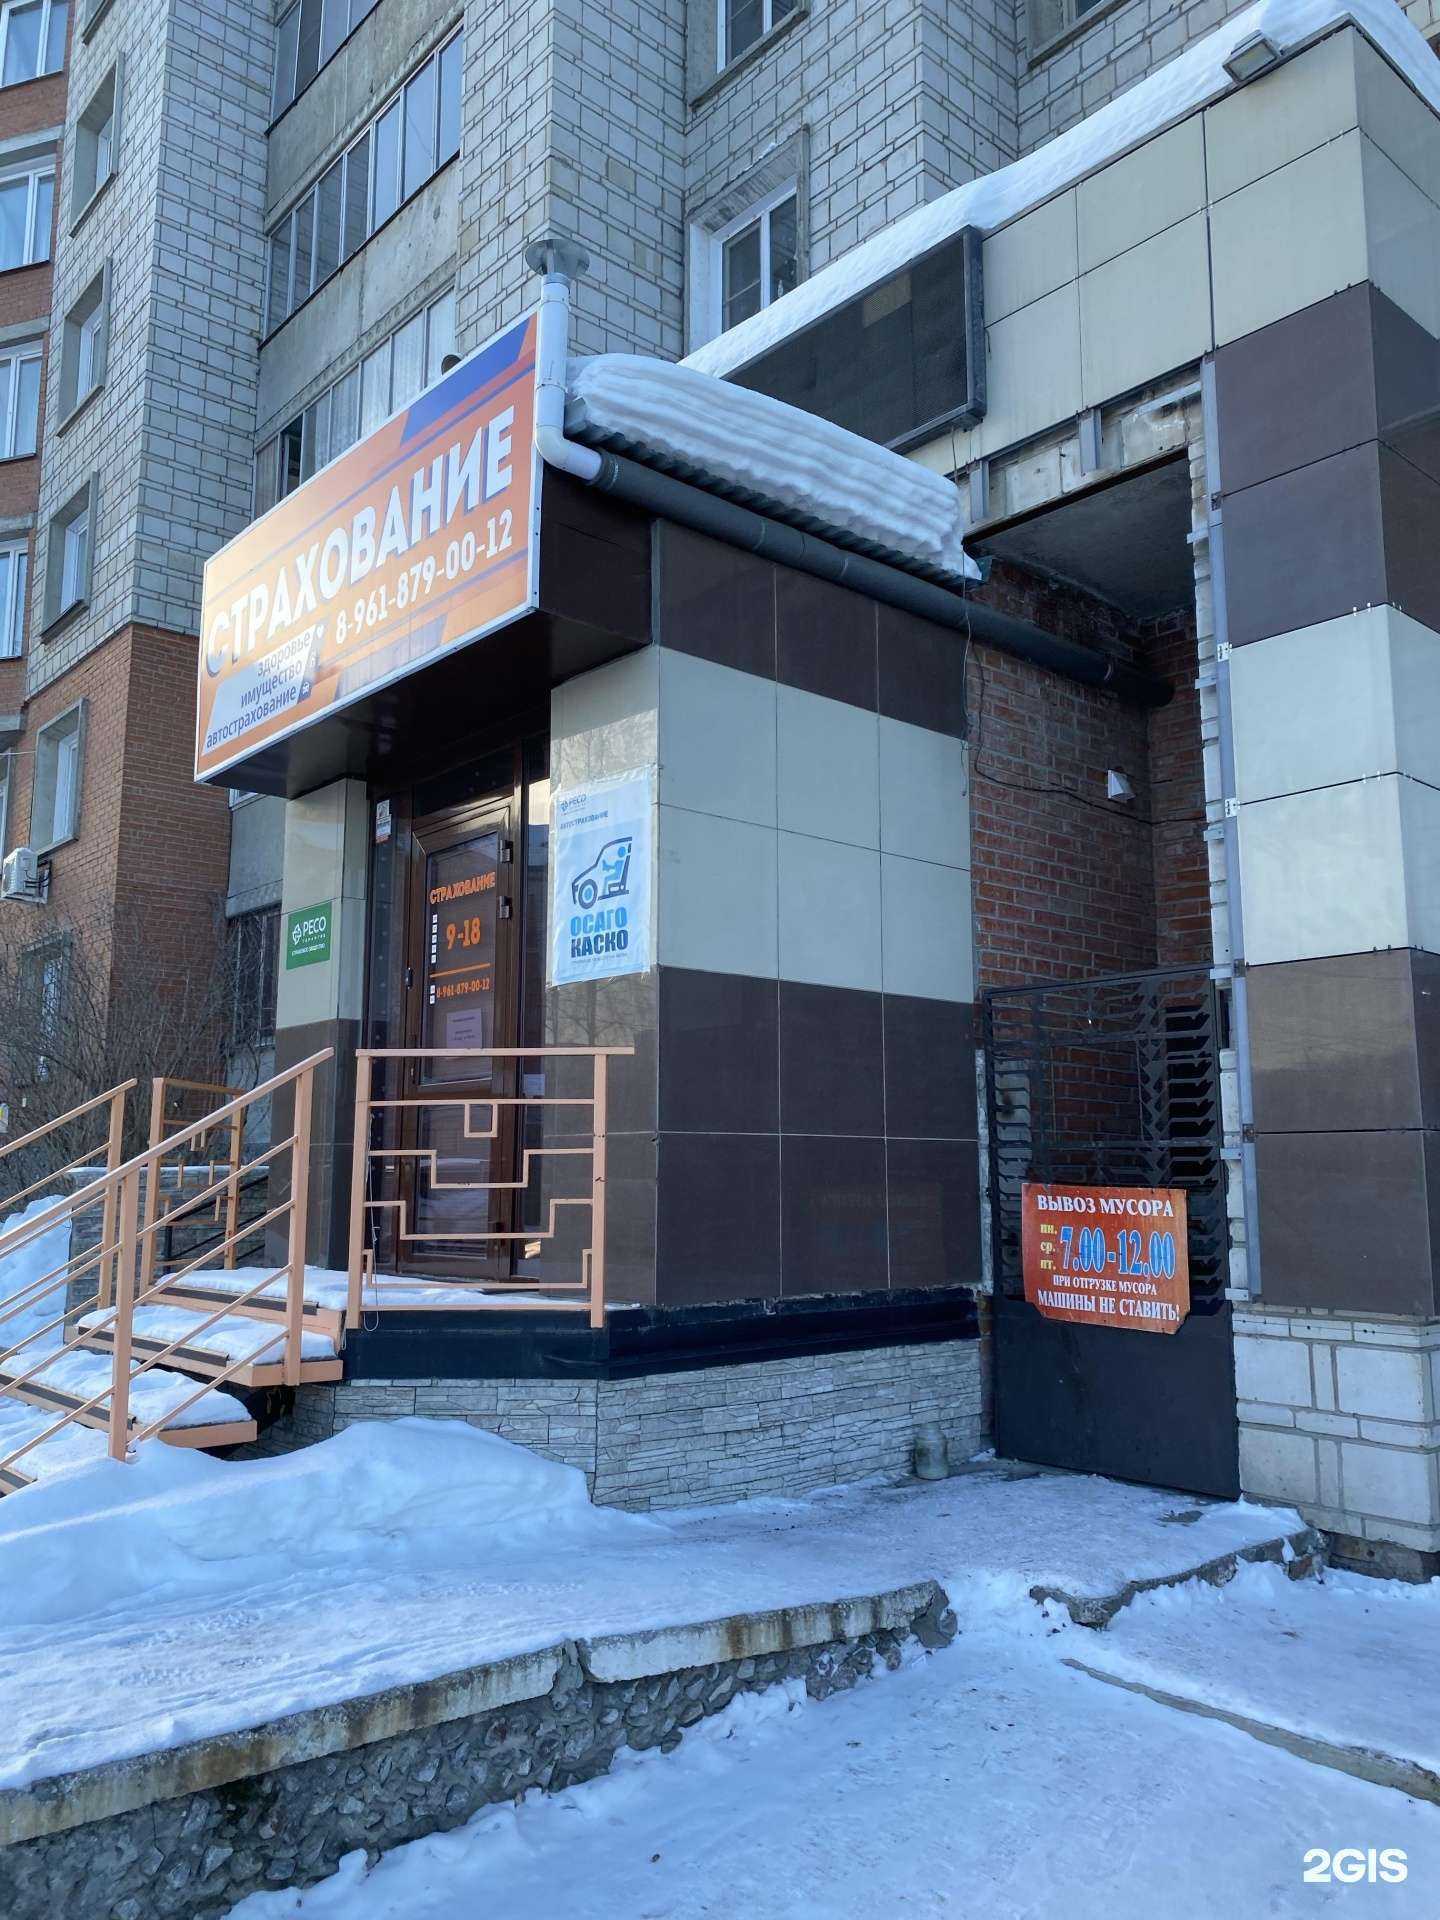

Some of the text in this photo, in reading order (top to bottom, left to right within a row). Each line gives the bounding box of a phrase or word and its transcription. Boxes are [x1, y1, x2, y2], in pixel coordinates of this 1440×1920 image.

[205, 405, 515, 677] СТРАХОВАНИЕ
[336, 509, 513, 644] 8-961-879-00-12
[257, 631, 310, 677] здоровье
[241, 660, 302, 708] имущество
[206, 685, 297, 748] автострахование
[429, 872, 496, 905] СТРАХОВАНИЕ
[303, 916, 326, 937] РЕСО
[446, 917, 481, 950] 9-18
[570, 906, 628, 937] ОСАГО
[570, 929, 629, 958] КАСКО
[1037, 1195, 1174, 1217] ВЫВОЗ МУСОРА
[1040, 1241, 1056, 1255] ср.
[1053, 1274, 1157, 1296] ПРИ ОТГРУЗКЕ МУСОРА
[1037, 1289, 1180, 1322] МАШИНЫ НЕ СТАВИТЬ!
